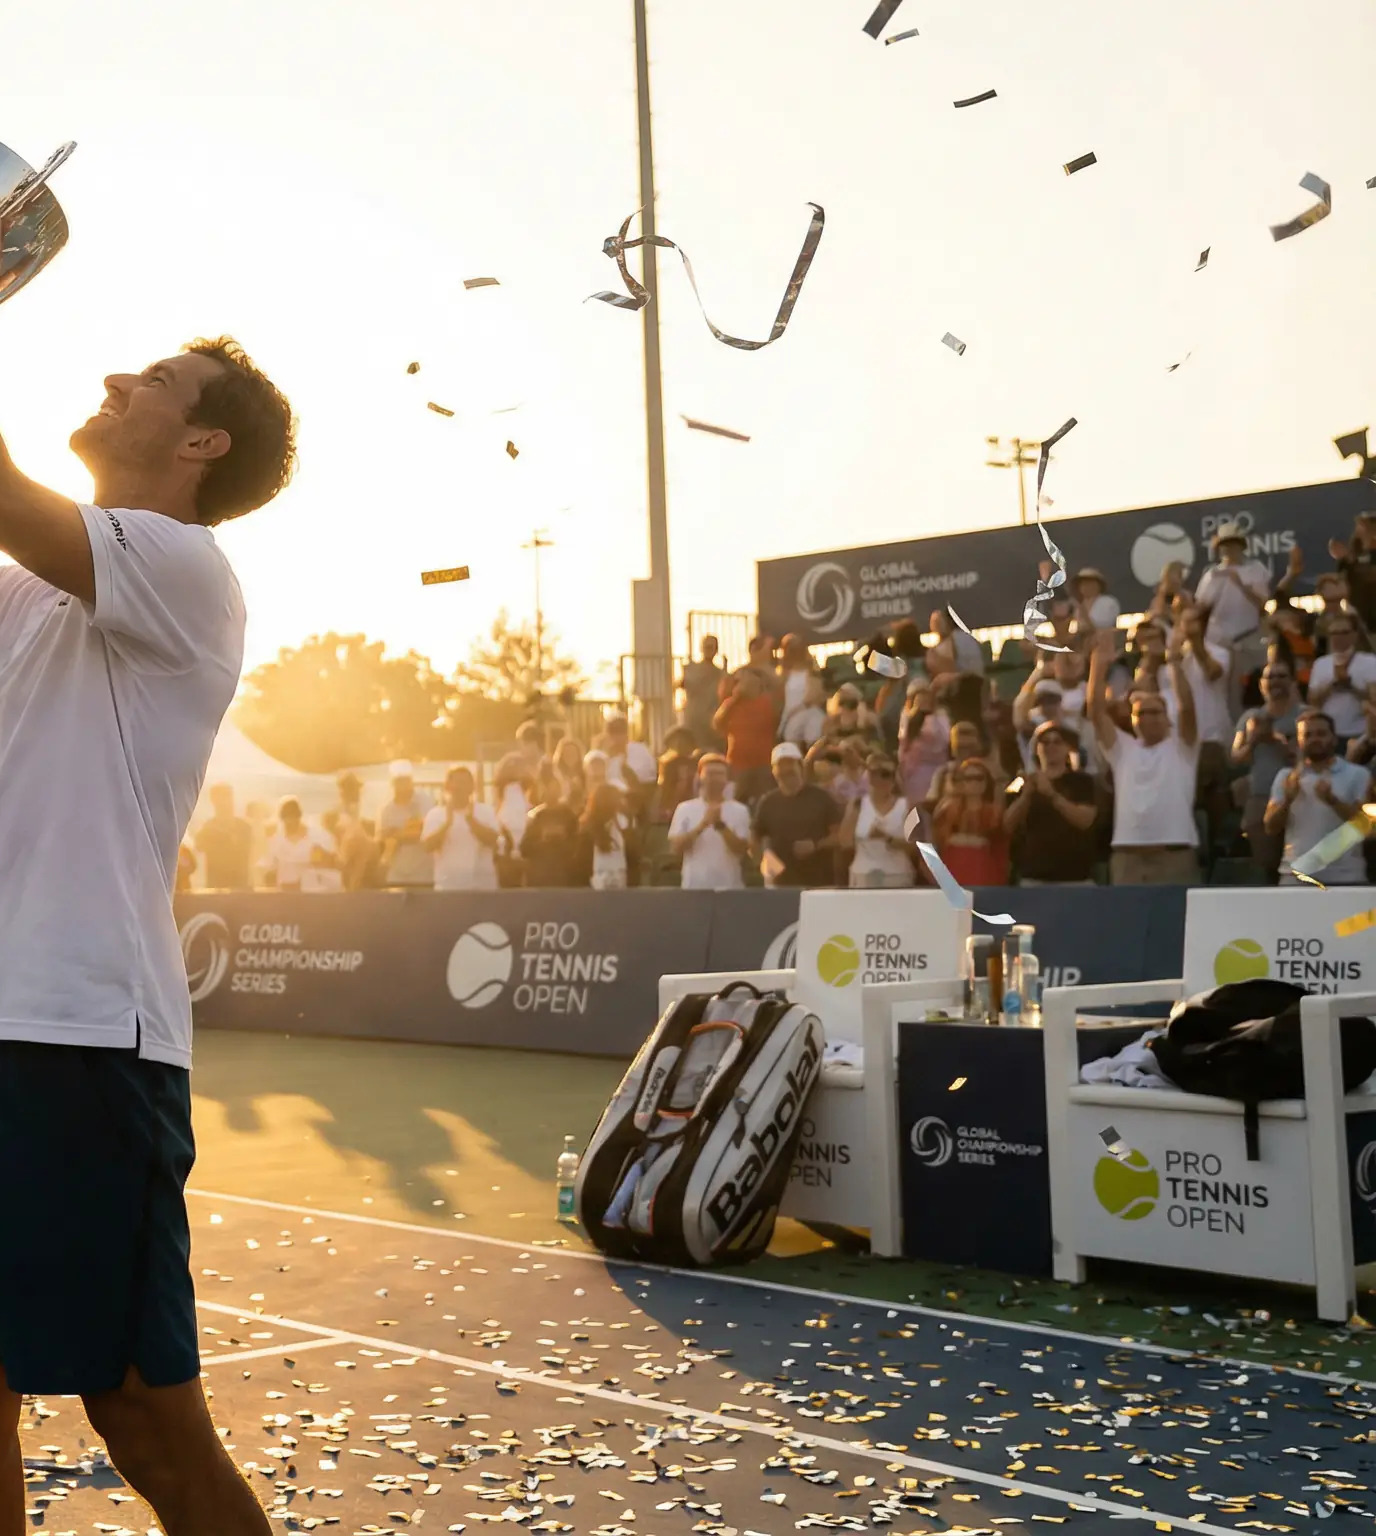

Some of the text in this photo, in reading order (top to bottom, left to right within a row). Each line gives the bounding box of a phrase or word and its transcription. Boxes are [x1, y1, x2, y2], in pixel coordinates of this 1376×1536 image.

[1201, 530, 1297, 561] TNIS
[860, 561, 919, 582] GLOBAL
[860, 571, 979, 599] CHAMPIONSHIP
[238, 924, 302, 945] GLOBAL
[524, 922, 580, 950] PRO
[865, 934, 901, 951] PRO
[1276, 938, 1324, 957] PRO
[235, 948, 364, 972] CHAMPIONSHIP
[520, 953, 619, 983] TENNIS
[865, 952, 928, 970] TENNIS
[1275, 960, 1362, 980] TENNIS
[231, 972, 287, 994] SERIES
[513, 984, 588, 1014] OPEN
[798, 1142, 851, 1165] NNIS
[1165, 1150, 1222, 1176] PRO
[790, 1164, 832, 1188] PEN
[1165, 1177, 1269, 1208] TENNIS
[1167, 1204, 1245, 1235] OPEN
